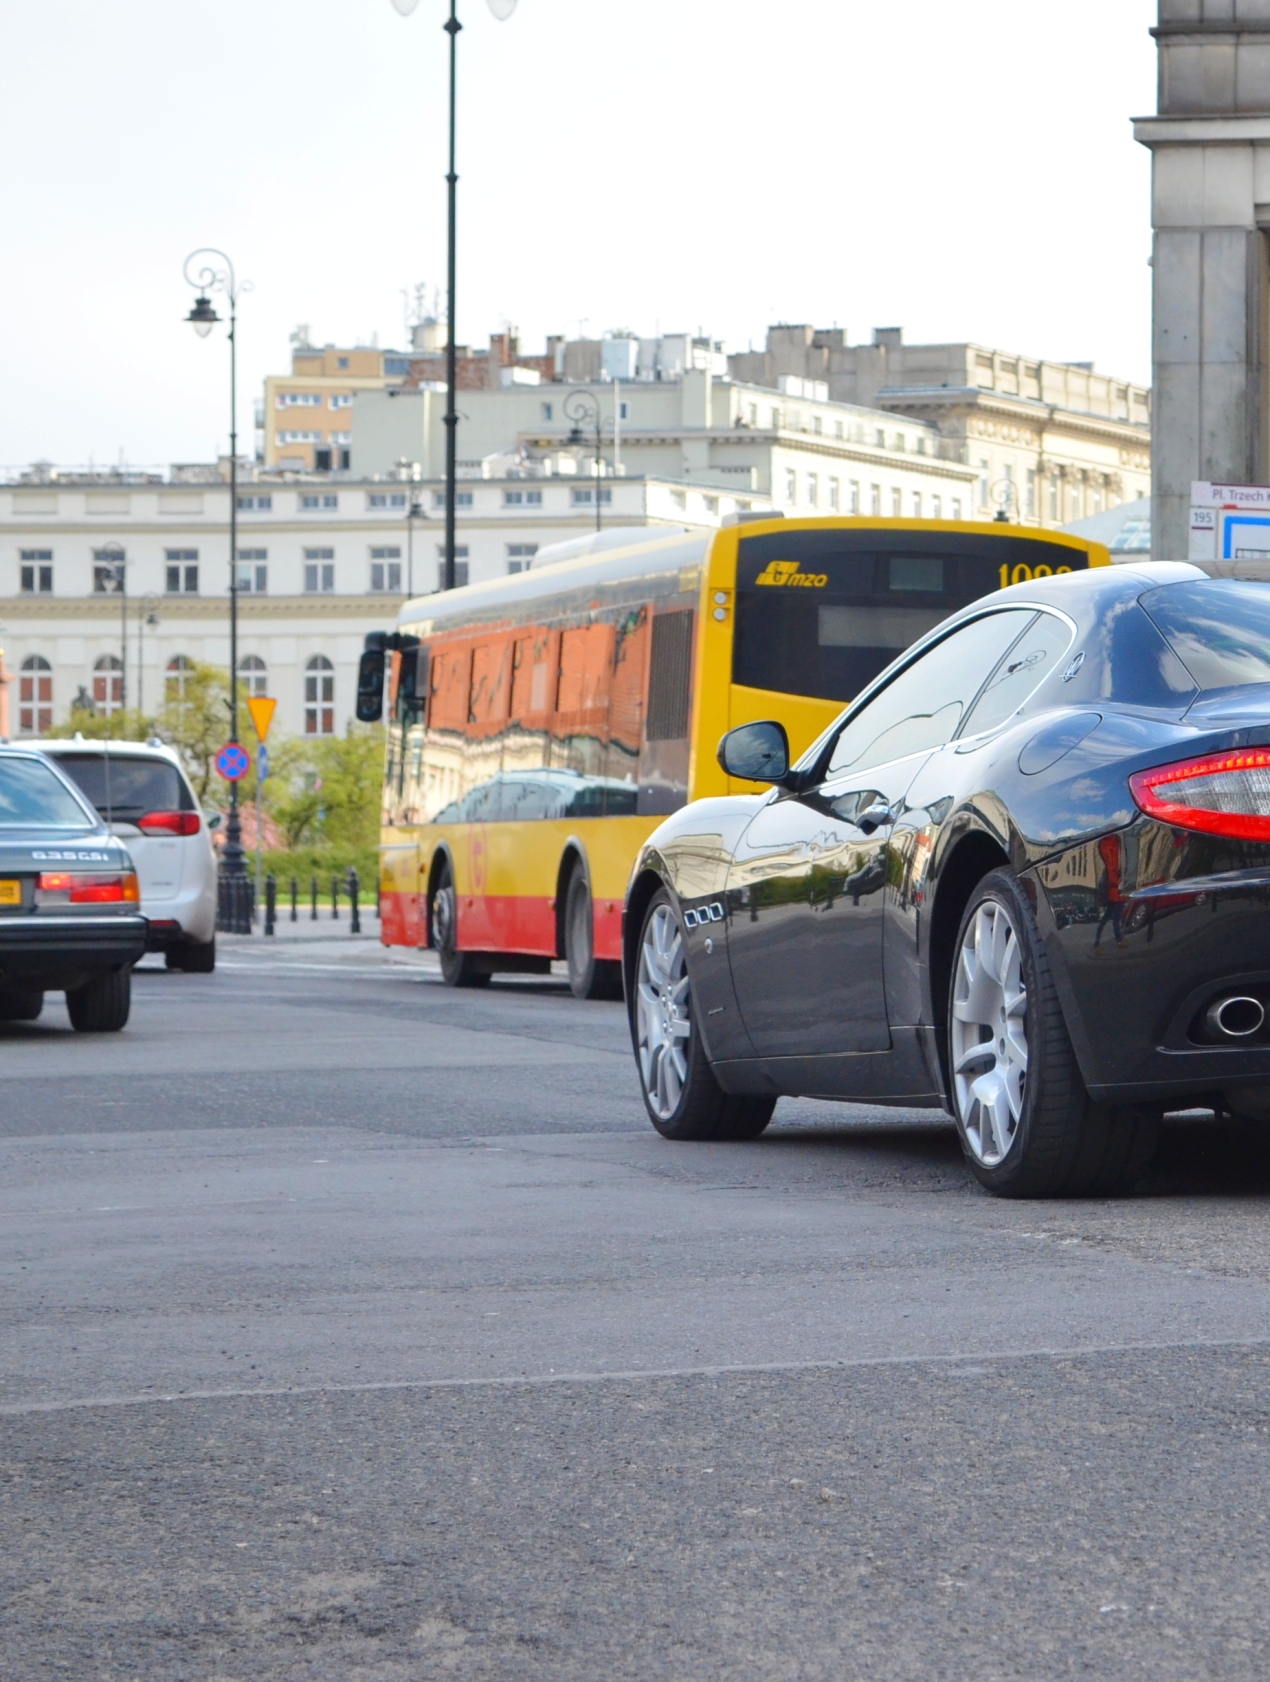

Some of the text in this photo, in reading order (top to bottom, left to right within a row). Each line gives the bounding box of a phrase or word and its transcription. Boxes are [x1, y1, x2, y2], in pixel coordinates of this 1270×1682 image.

[1213, 486, 1225, 500] Pl.
[1229, 489, 1264, 502] Trzech
[1194, 512, 1212, 523] 195
